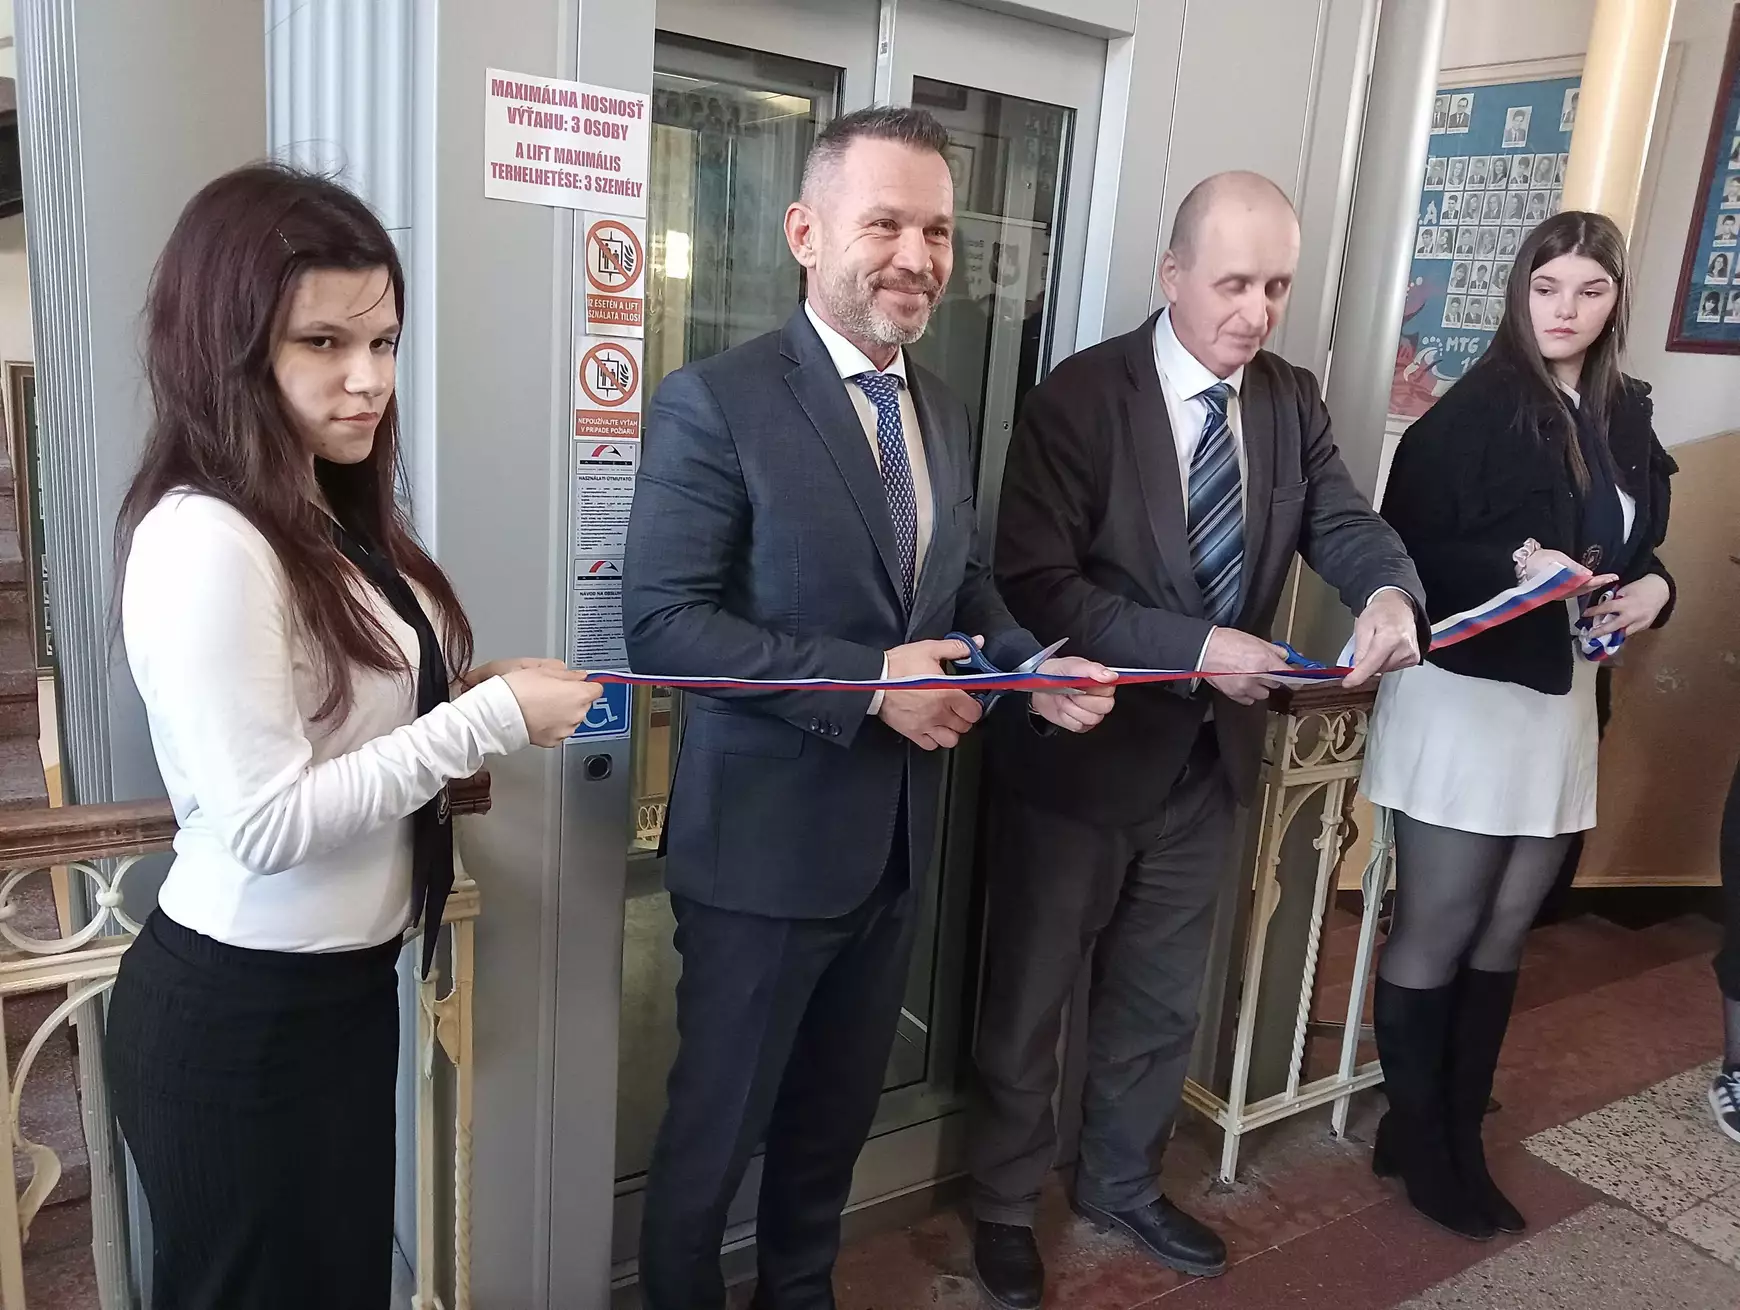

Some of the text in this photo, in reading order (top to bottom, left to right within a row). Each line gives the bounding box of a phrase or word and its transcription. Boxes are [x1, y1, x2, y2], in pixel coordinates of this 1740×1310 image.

[491, 78, 644, 120] MAXIMÁLNA NOSNOSŤ
[507, 106, 629, 141] VÝŤAHU: 3 OSOBY
[515, 142, 621, 172] A LIFT MAXIMÁLIS
[491, 162, 643, 198] TERHELHETÉSE: 3 SZEMÉLY
[1446, 336, 1480, 353] MTG
